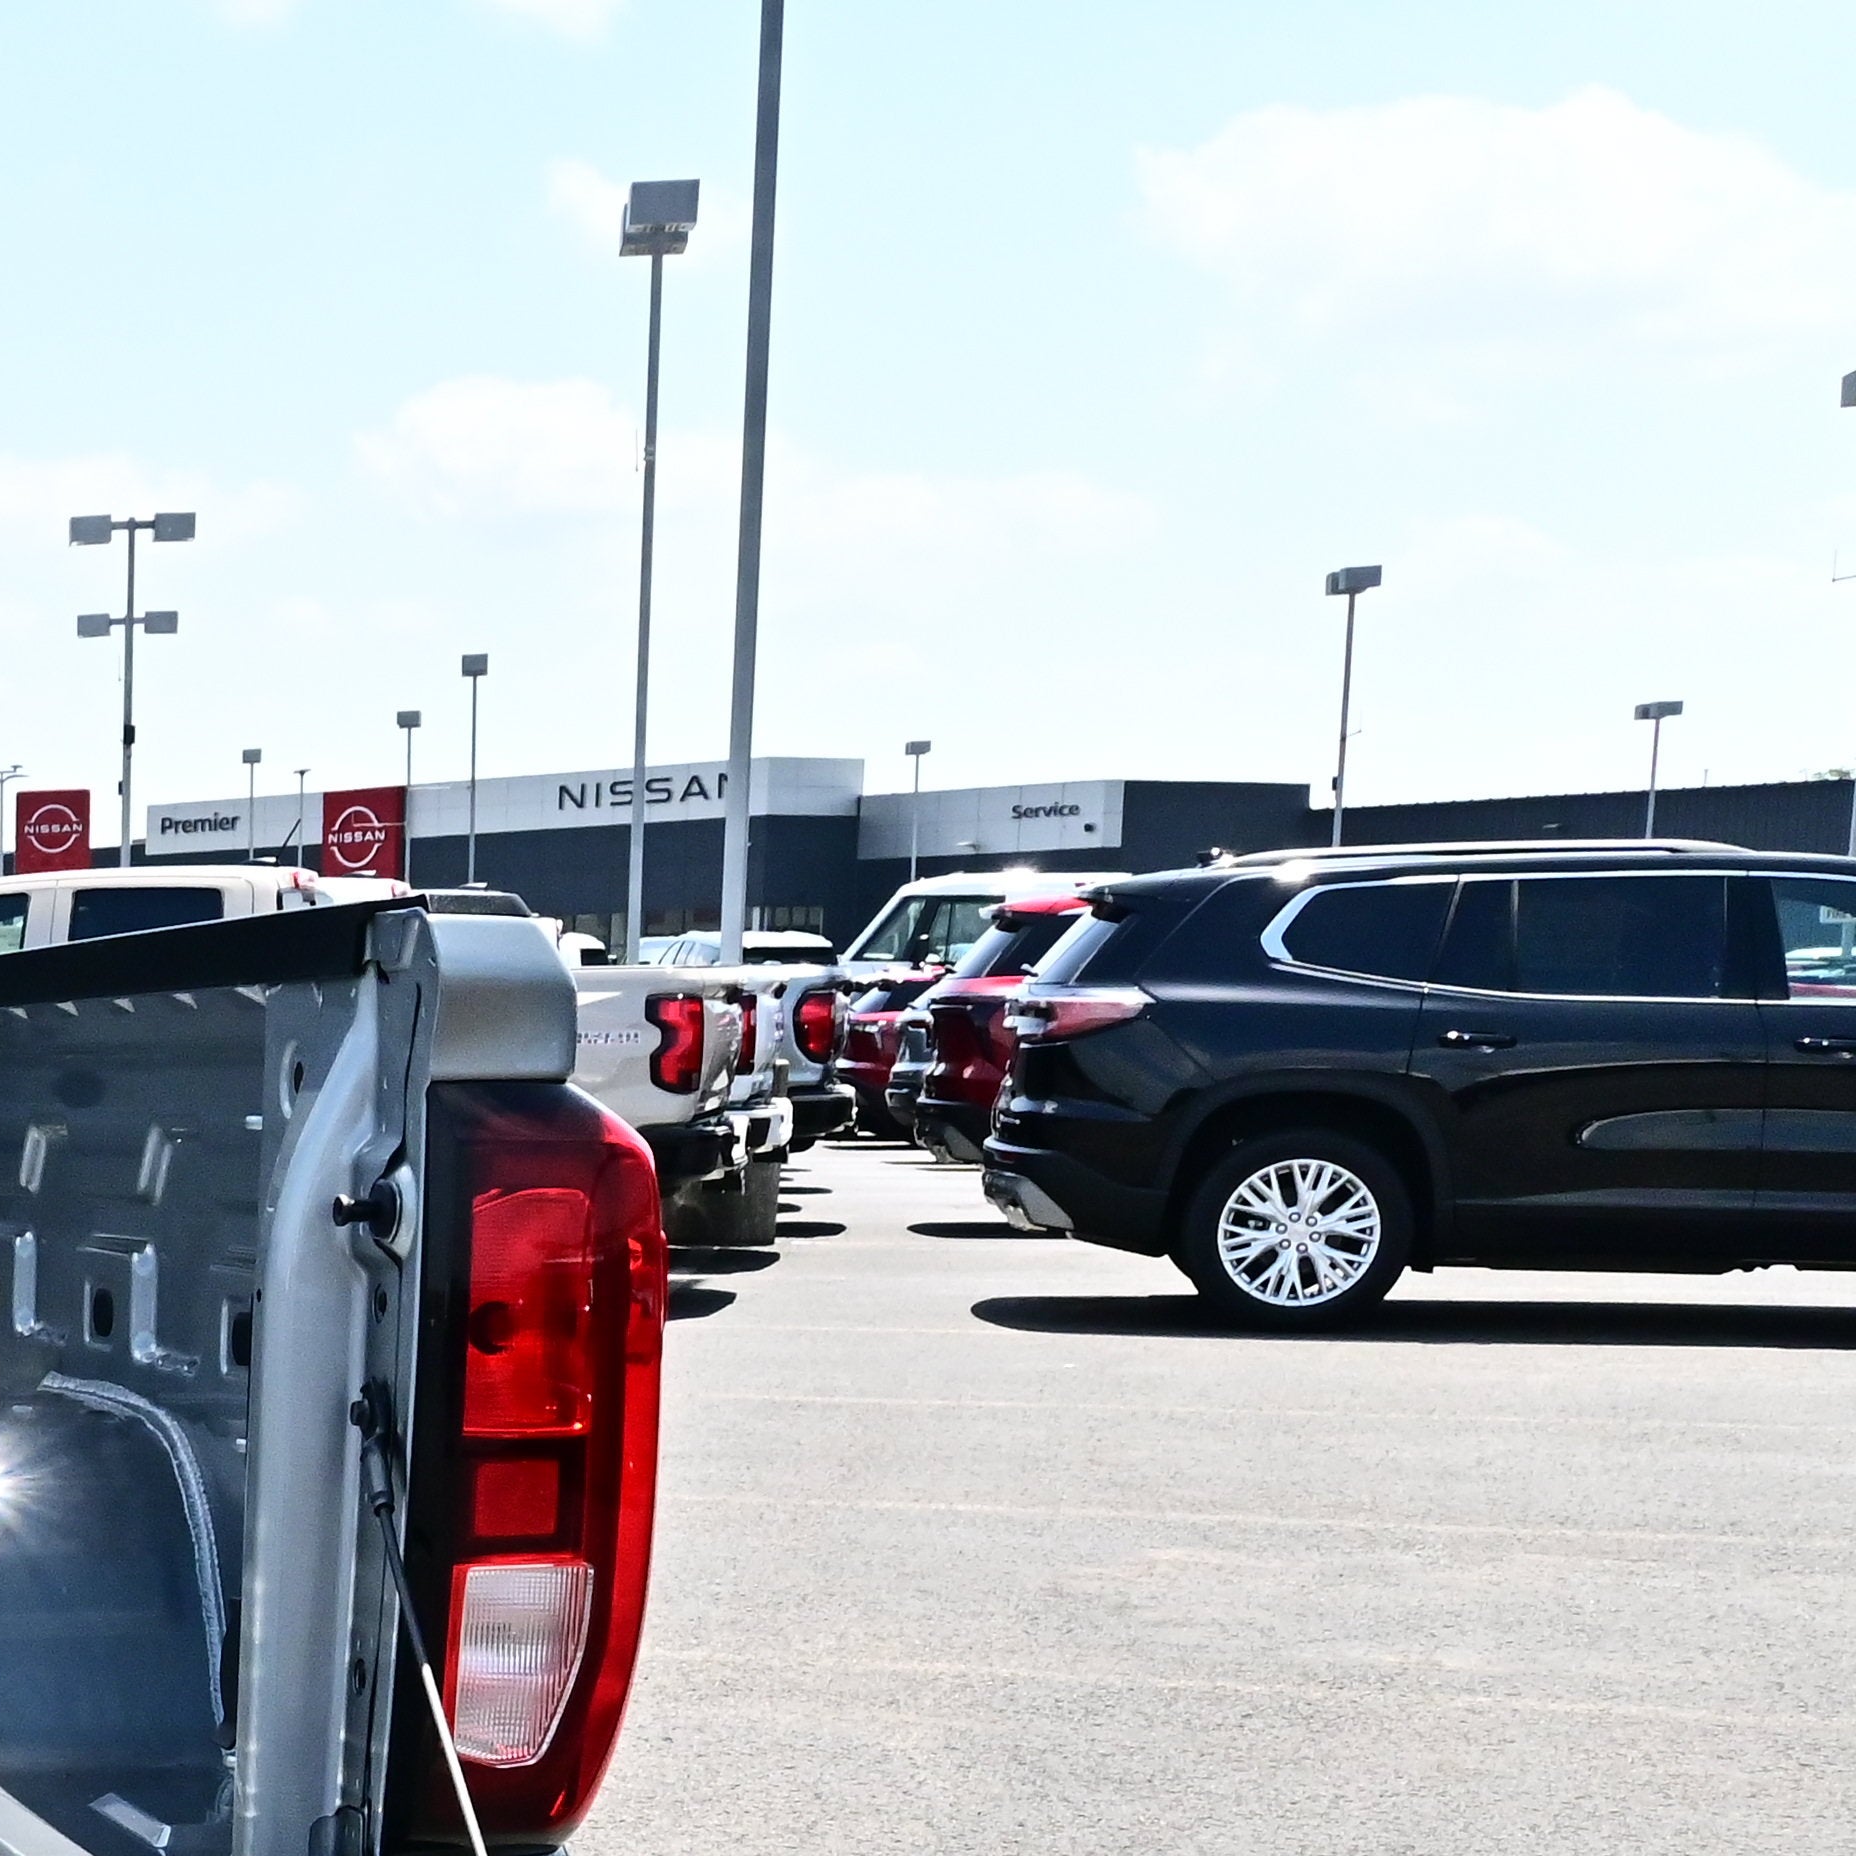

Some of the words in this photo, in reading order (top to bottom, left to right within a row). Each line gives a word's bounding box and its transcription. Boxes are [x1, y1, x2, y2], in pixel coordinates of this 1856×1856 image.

[1011, 801, 1081, 819] Service
[24, 823, 83, 835] NISSAN
[160, 811, 241, 835] Premier
[328, 829, 386, 845] NISSAN
